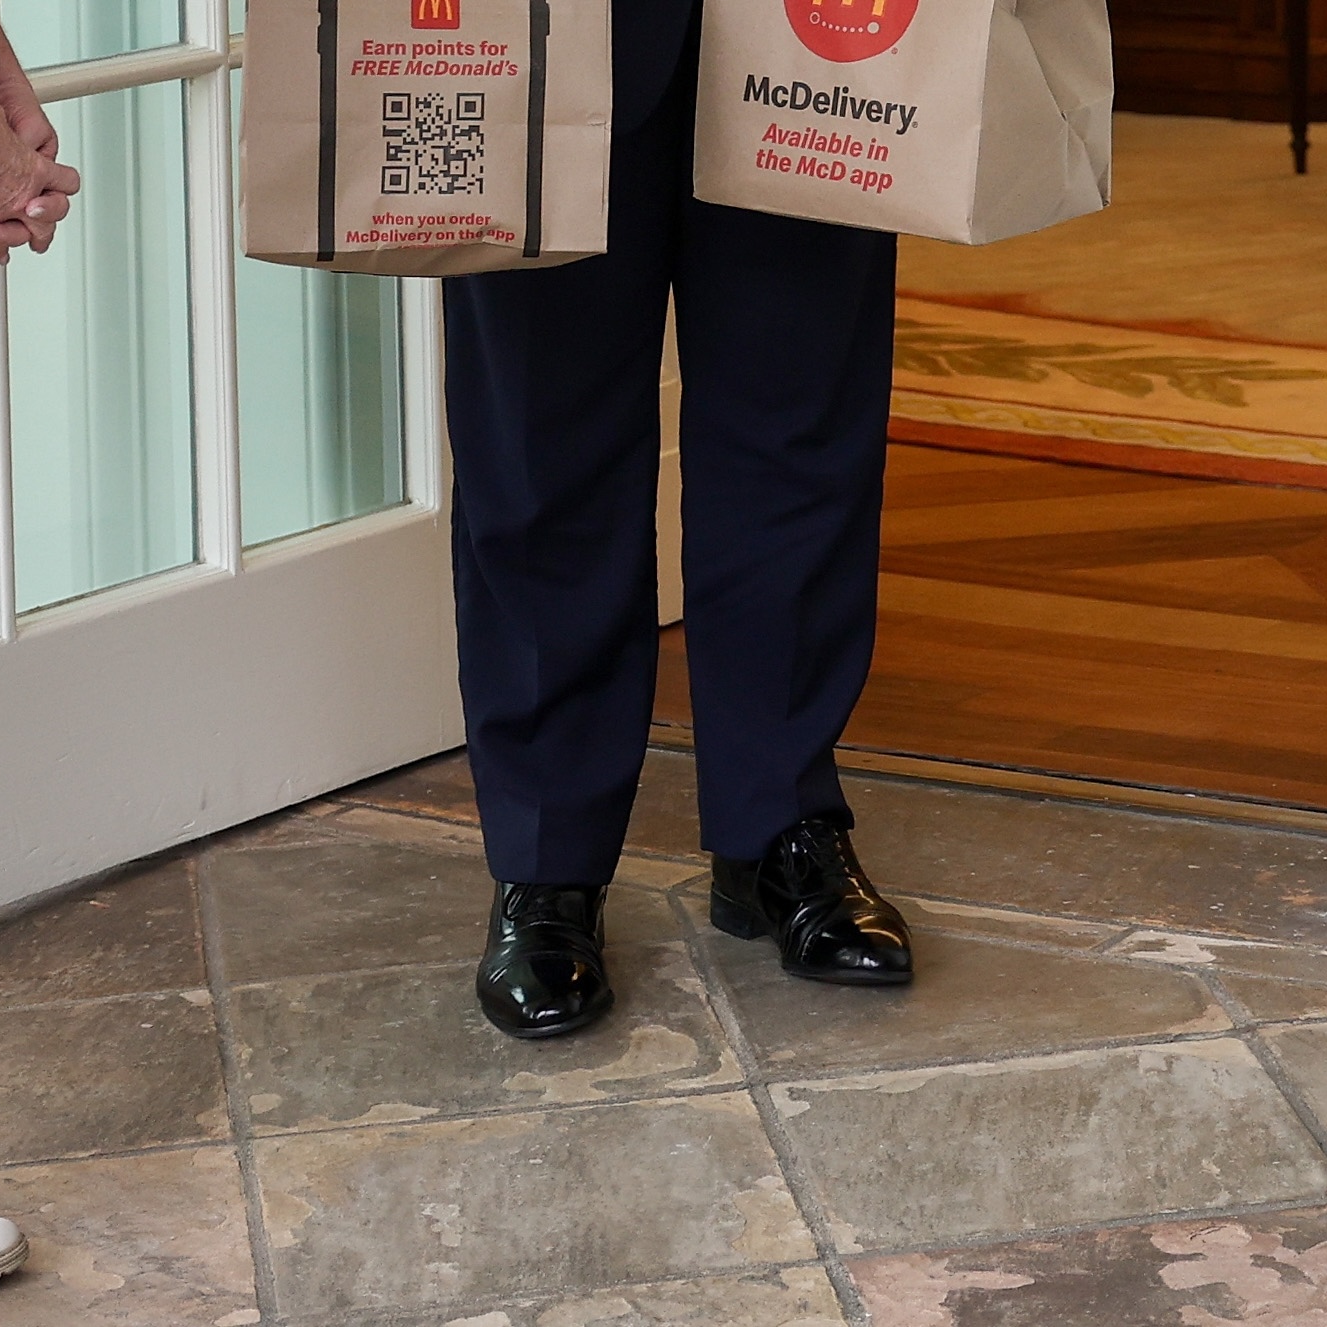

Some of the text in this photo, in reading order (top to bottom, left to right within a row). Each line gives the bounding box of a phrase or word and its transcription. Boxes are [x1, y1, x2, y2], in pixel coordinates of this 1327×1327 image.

[362, 40, 508, 59] Earn points for
[351, 60, 518, 76] FREE McDonald's
[743, 74, 918, 135] McDelivery
[762, 123, 889, 162] Available in
[756, 149, 893, 193] the McD app
[372, 212, 492, 228] when you order
[346, 228, 515, 243] McDelivery on the app
